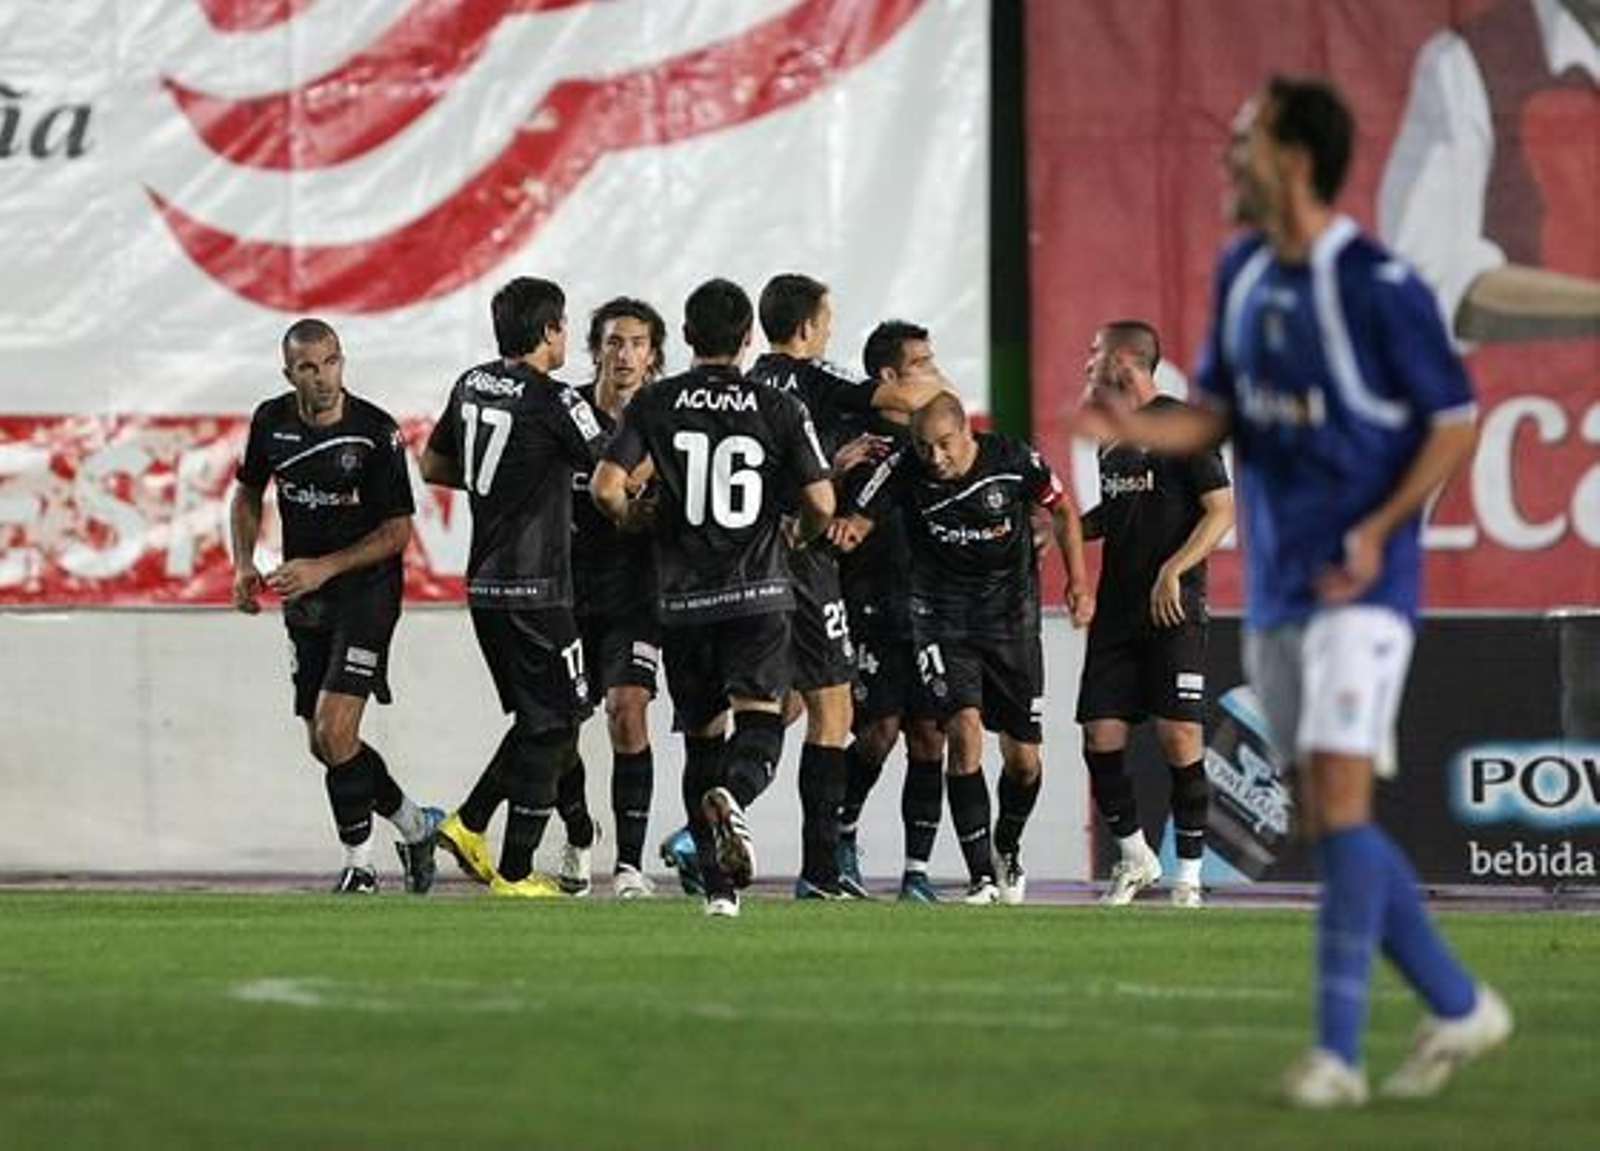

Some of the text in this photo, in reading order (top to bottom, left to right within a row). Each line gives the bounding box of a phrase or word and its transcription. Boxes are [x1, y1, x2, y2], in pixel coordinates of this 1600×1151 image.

[674, 385, 758, 411] ACUÑA
[461, 402, 512, 496] 17
[280, 482, 361, 509] Cajasol
[673, 430, 765, 528] 16
[928, 517, 1012, 546] Cajasol
[561, 638, 584, 680] 17
[916, 643, 946, 684] 21
[1467, 841, 1597, 877] bebida
